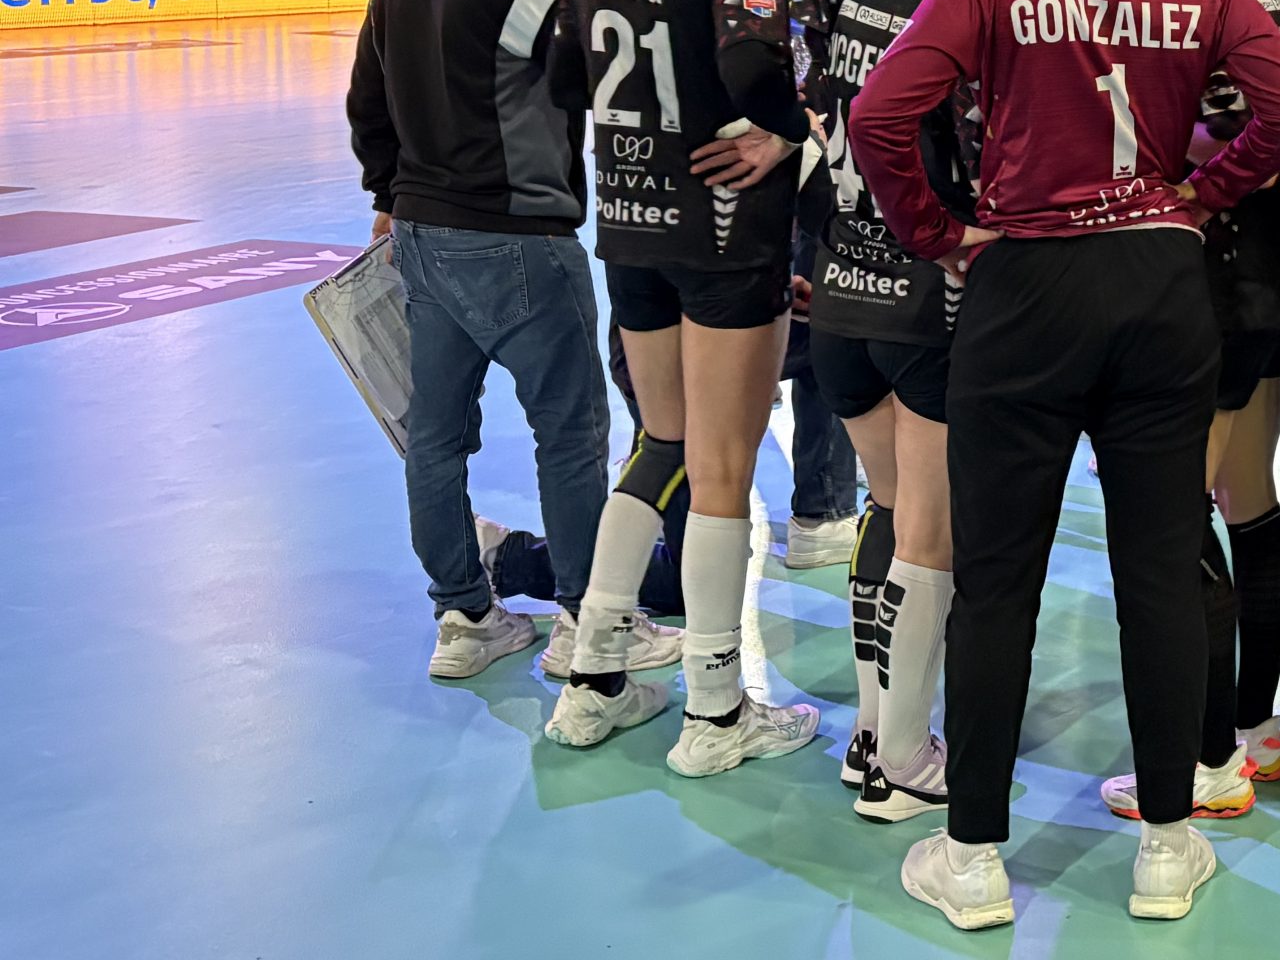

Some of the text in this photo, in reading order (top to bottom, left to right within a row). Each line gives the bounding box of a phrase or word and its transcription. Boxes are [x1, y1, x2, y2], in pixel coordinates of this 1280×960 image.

[591, 8, 682, 133] 21
[828, 97, 884, 218] 4
[1095, 63, 1138, 180] 1
[0, 248, 275, 308] ONCESSIONNAIRE
[117, 250, 354, 301] SANY
[823, 262, 911, 297] Politec
